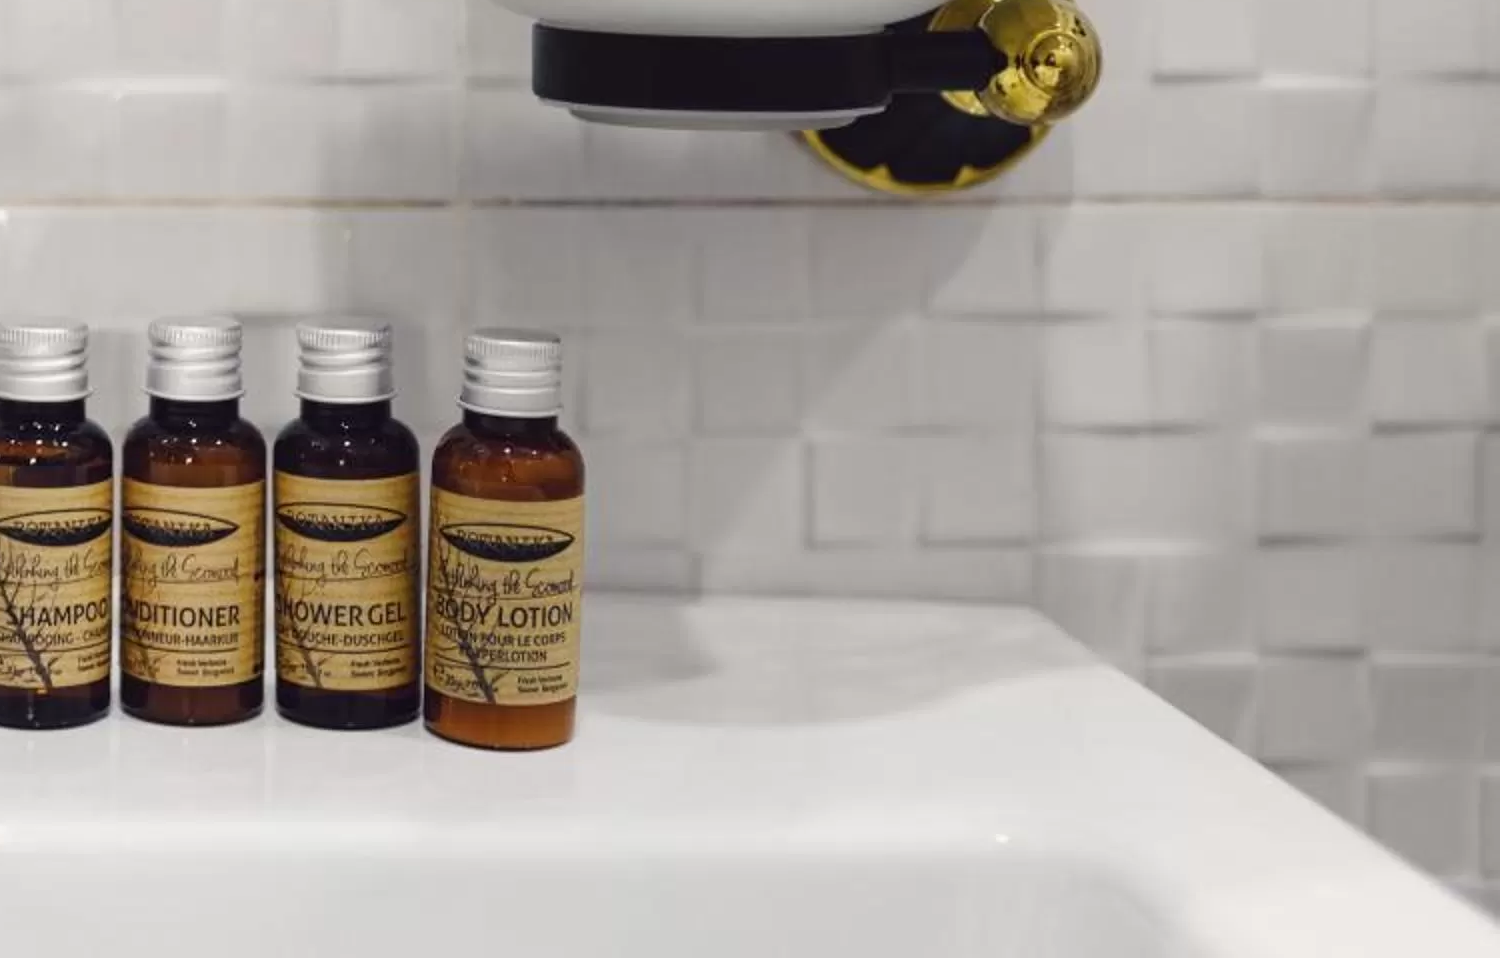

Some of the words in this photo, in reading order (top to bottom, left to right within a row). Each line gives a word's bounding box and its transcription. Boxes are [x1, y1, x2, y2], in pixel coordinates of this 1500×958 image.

[5, 597, 108, 627] SHAMPOO
[126, 598, 240, 628] NDITIONER
[367, 601, 408, 626] GEL
[435, 594, 493, 625] BODY
[498, 601, 573, 629] LOTION
